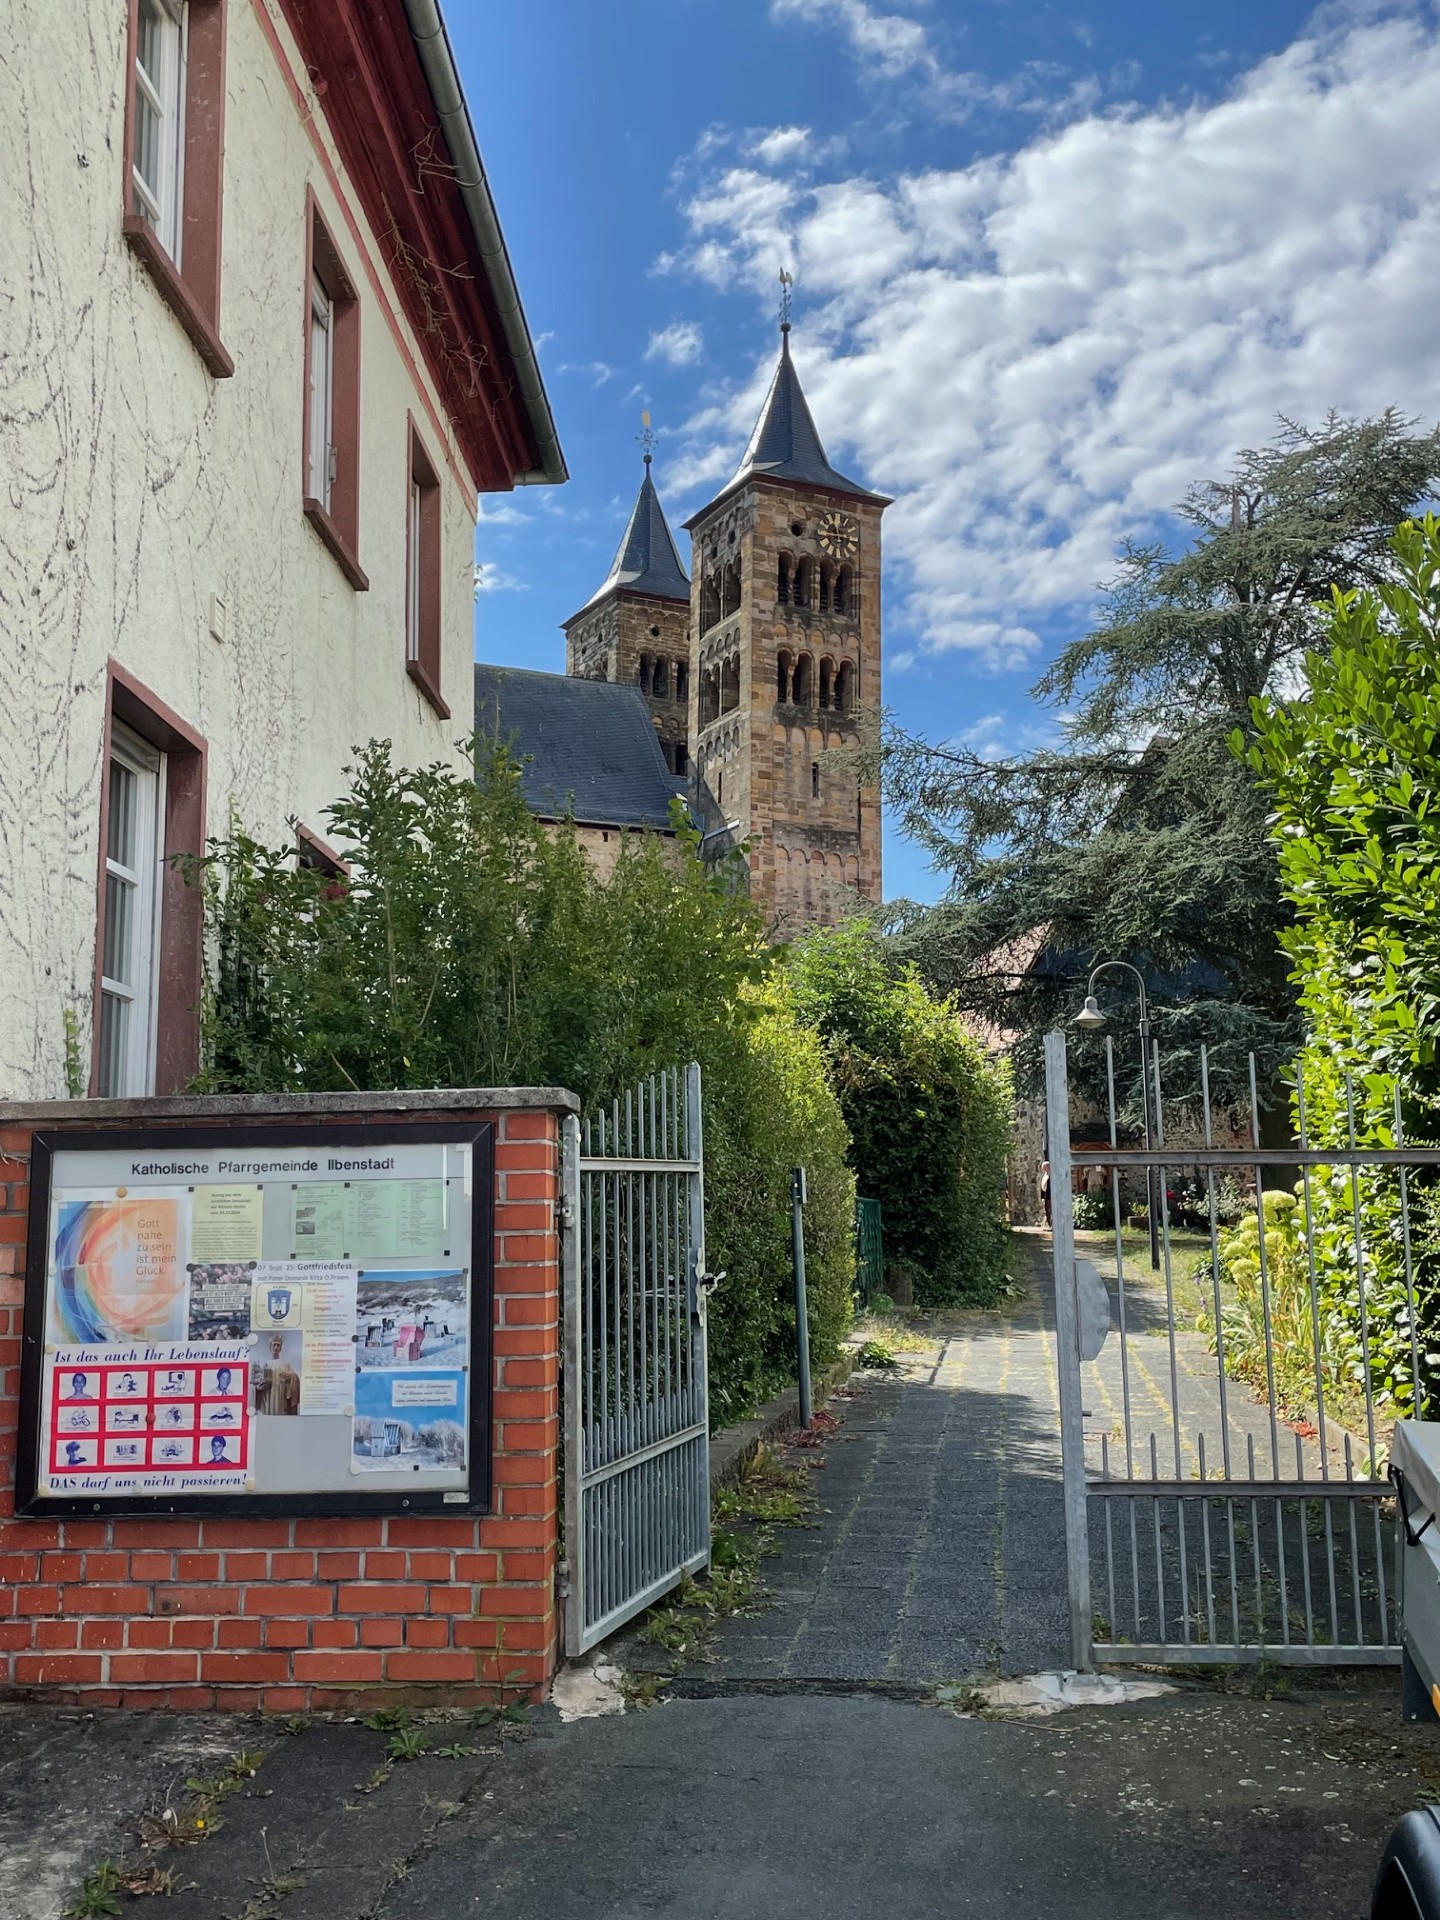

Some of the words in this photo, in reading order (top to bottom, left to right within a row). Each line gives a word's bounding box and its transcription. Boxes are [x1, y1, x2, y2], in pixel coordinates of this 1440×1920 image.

[131, 1162, 209, 1175] Katholische
[218, 1160, 318, 1175] Pfarrgemeinde
[328, 1158, 395, 1171] Ilbenstadt
[137, 1219, 160, 1228] Gott
[137, 1230, 162, 1240] nahe
[137, 1244, 148, 1252] zu
[151, 1243, 172, 1251] sein
[136, 1254, 149, 1263] ist
[151, 1255, 177, 1263] mein
[297, 1262, 352, 1271] Gottfriedsfest
[54, 1351, 71, 1362] Ist
[76, 1350, 99, 1362] das
[104, 1349, 137, 1361] auch
[143, 1348, 164, 1361] Ihr
[169, 1346, 251, 1361] Lebenslauf?
[50, 1477, 76, 1489] DAS
[81, 1477, 112, 1490] darf
[115, 1479, 137, 1487] uns
[143, 1475, 175, 1487] nicht
[180, 1473, 247, 1488] passieren!
